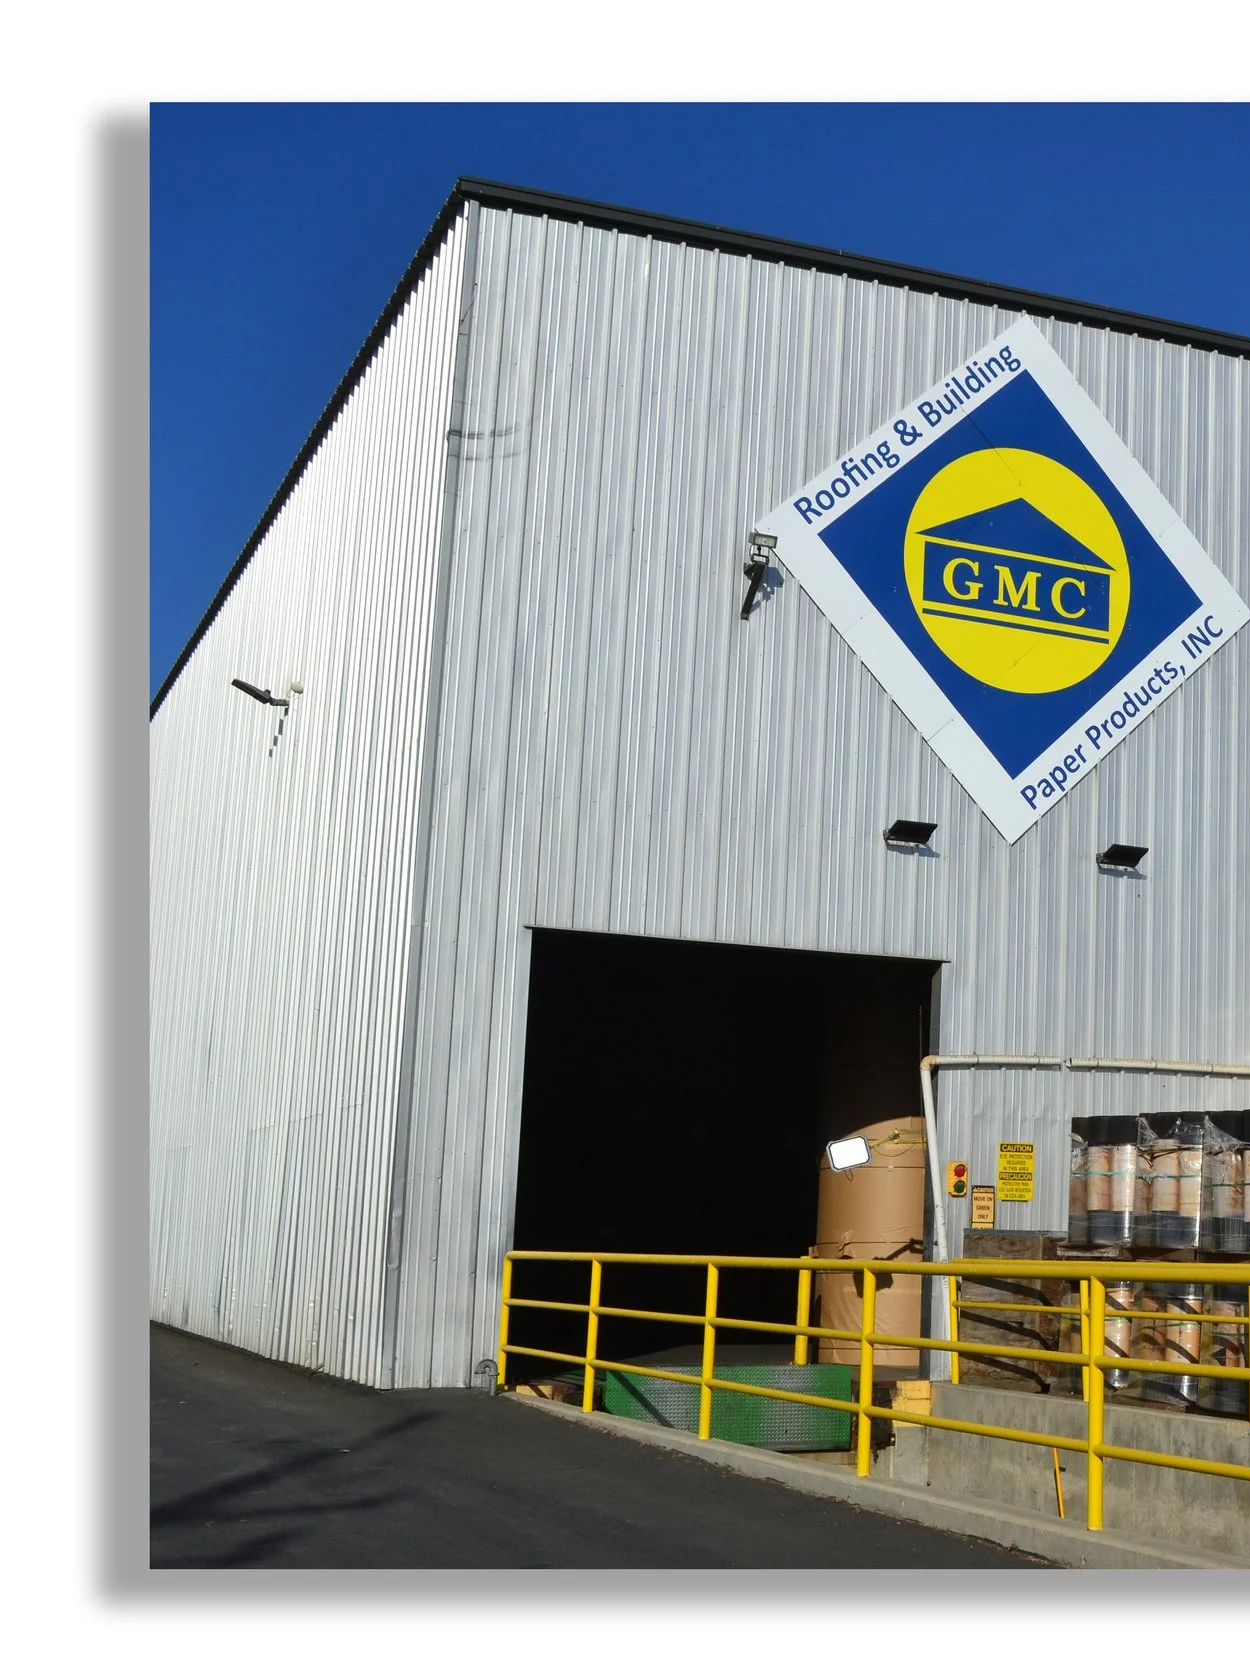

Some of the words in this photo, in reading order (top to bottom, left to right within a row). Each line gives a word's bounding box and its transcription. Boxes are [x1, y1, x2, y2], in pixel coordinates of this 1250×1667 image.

[794, 440, 901, 525] Roofing
[894, 420, 923, 447] &
[917, 345, 1022, 427] Building
[943, 558, 1086, 619] GMC
[1020, 745, 1087, 810] Paper
[1085, 657, 1189, 749] Products,
[1181, 616, 1223, 659] INC
[1002, 1144, 1032, 1152] CAUTION
